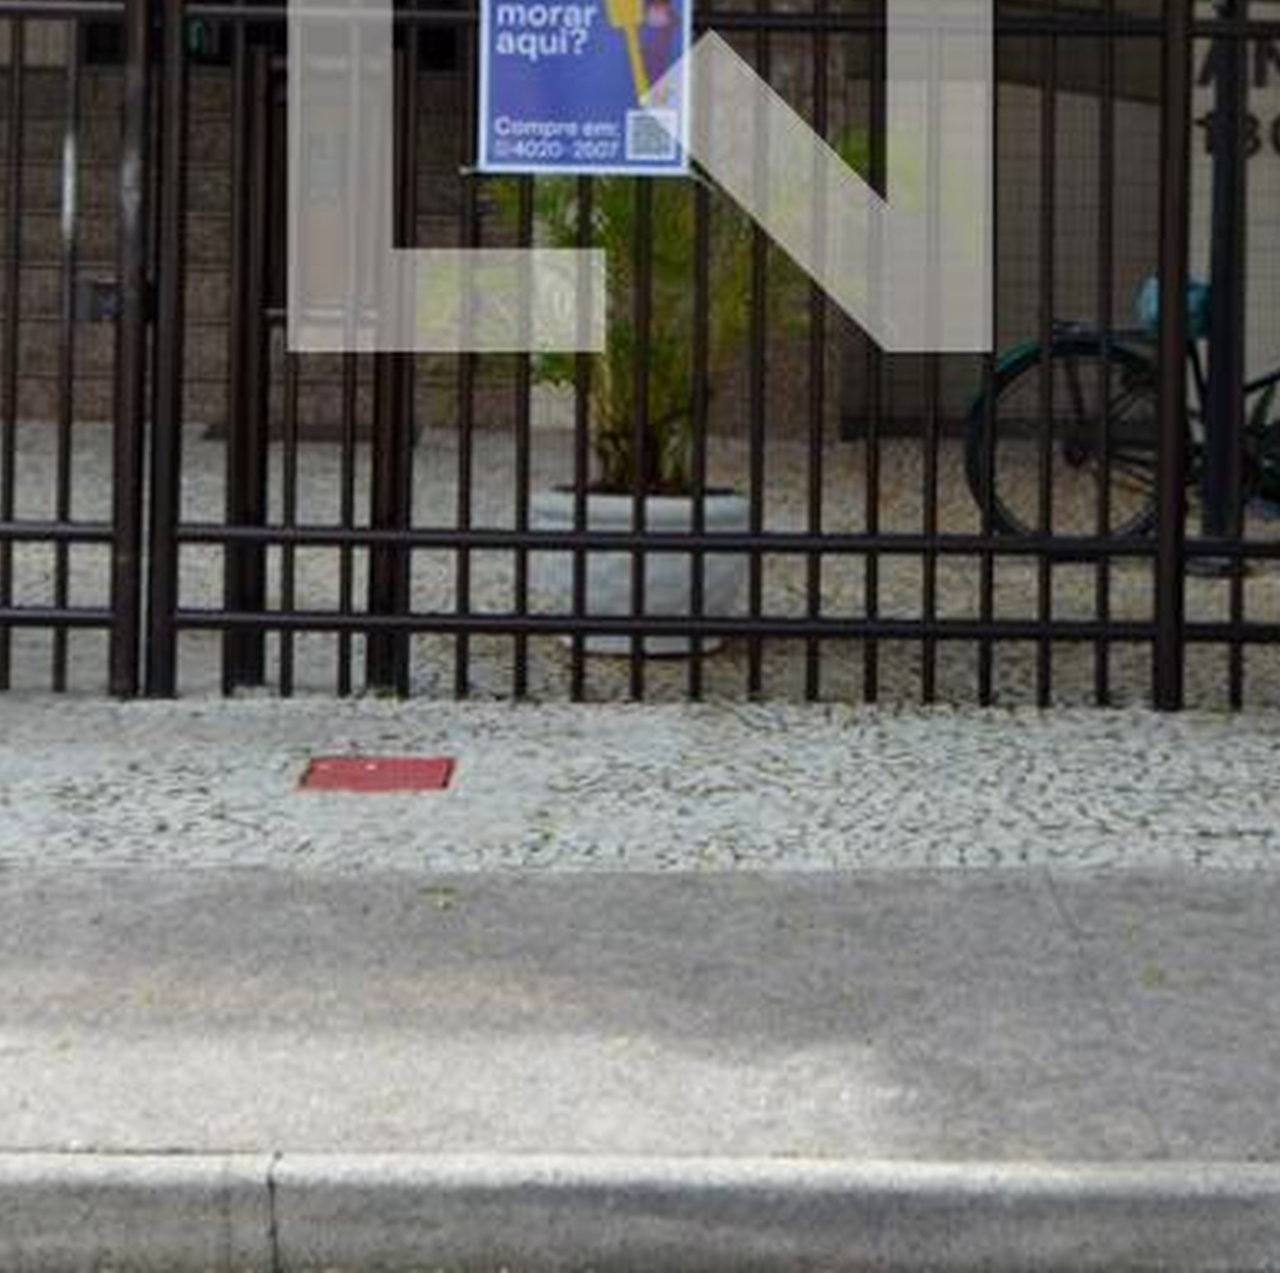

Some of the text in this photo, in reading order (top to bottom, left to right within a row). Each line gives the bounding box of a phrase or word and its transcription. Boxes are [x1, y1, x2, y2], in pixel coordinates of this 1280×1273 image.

[496, 3, 597, 27] morar
[496, 29, 588, 61] aqui?
[494, 116, 578, 138] Compre
